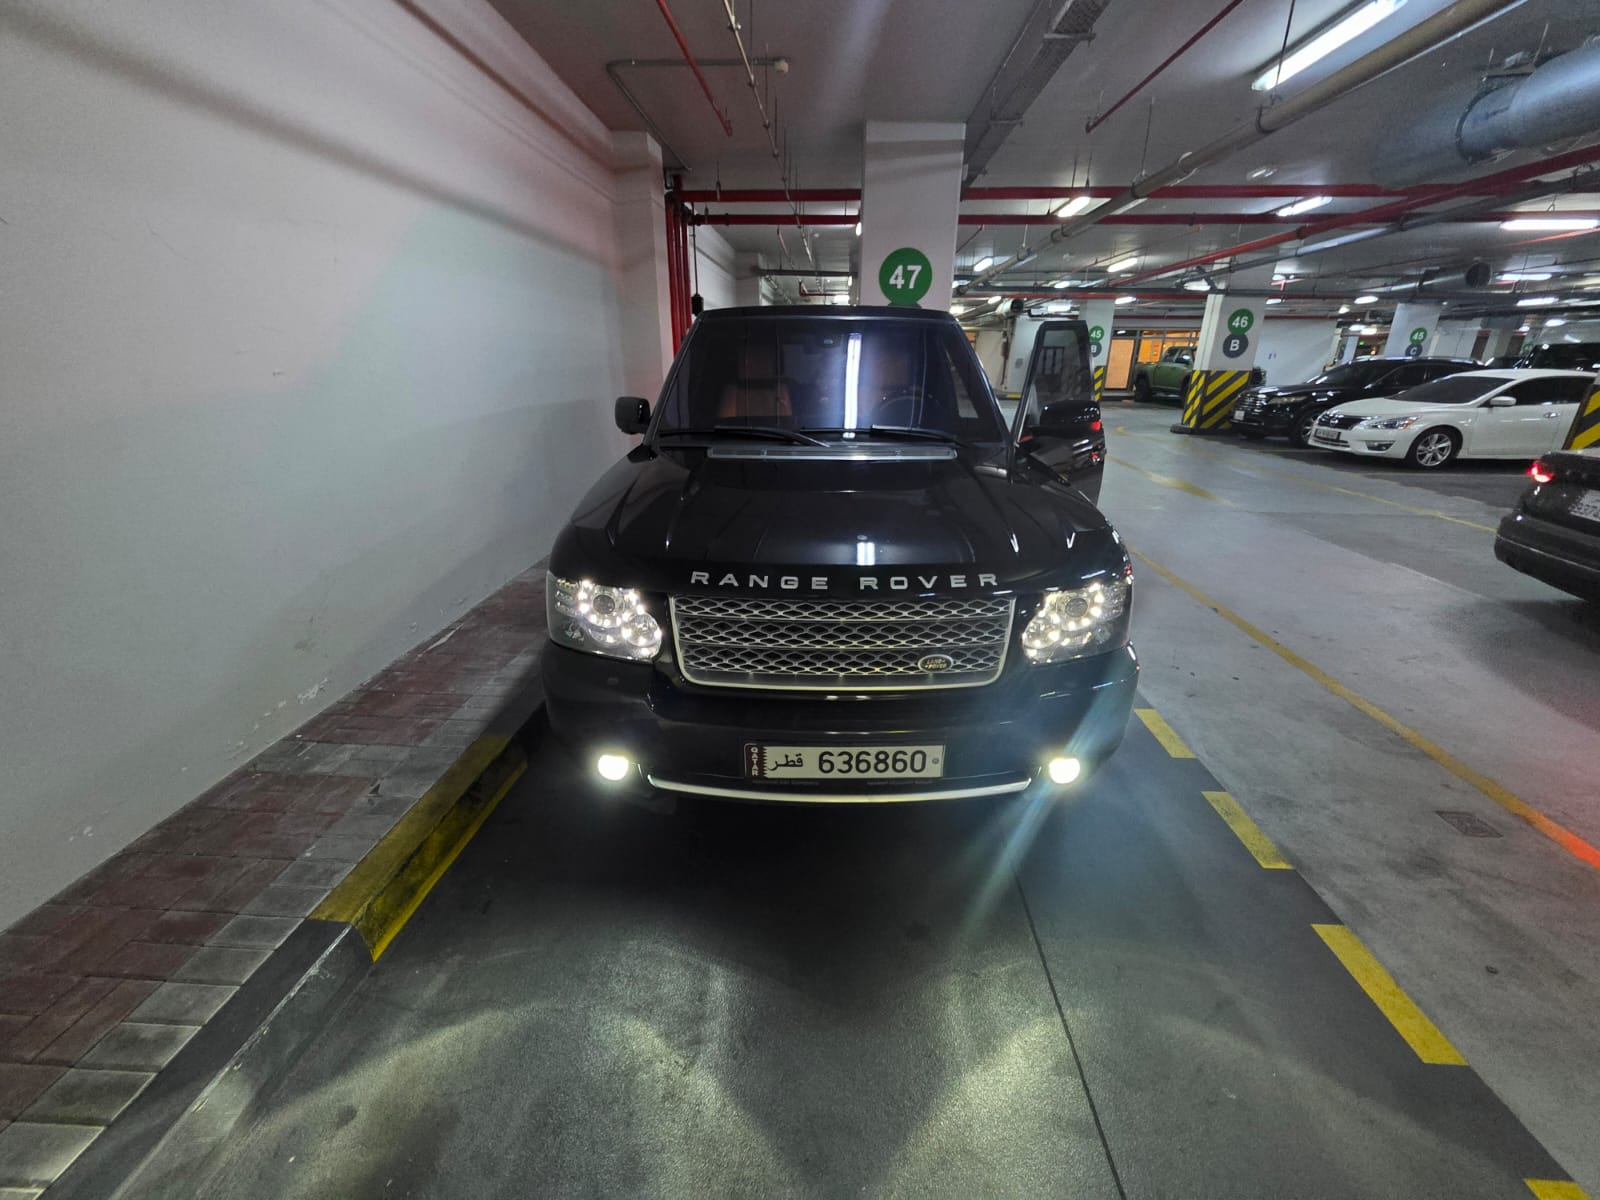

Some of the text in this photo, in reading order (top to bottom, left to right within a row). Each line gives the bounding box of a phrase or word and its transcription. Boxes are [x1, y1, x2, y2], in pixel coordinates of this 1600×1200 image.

[888, 264, 923, 289] 47
[1231, 316, 1249, 328] 46
[1090, 330, 1102, 339] 45
[1229, 339, 1240, 351] B
[1410, 346, 1418, 355] C
[690, 571, 998, 590] RANGE ROVER
[750, 746, 759, 777] QATAR
[767, 753, 804, 771] قطر
[818, 750, 927, 774] 636860
